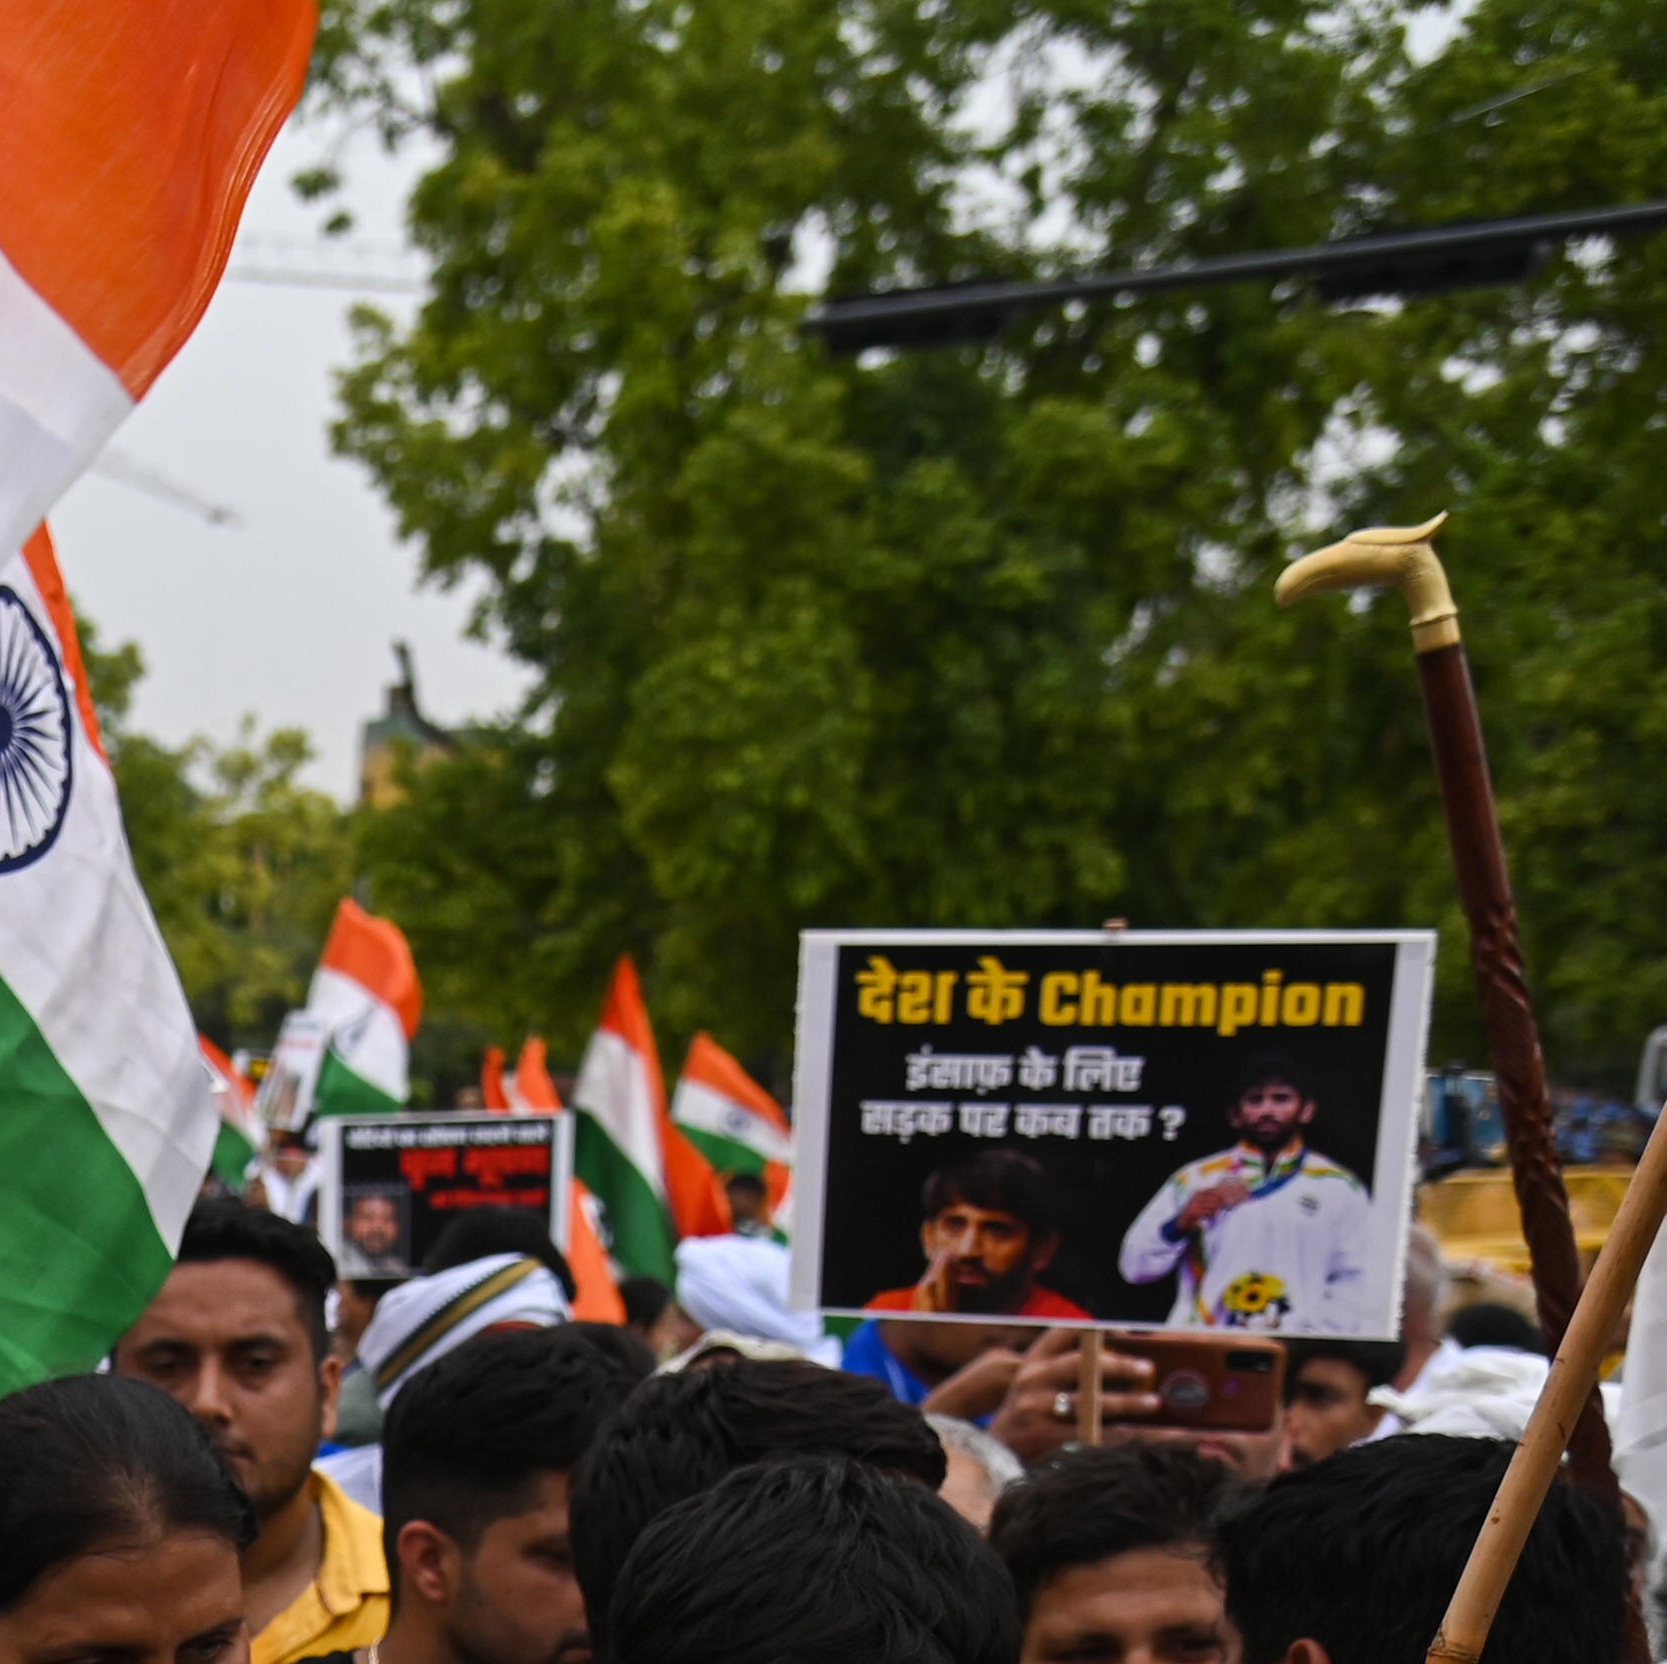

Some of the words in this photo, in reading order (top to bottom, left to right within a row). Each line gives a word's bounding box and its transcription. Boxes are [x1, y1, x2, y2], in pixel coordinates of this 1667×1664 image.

[855, 954, 959, 1025] देश
[966, 954, 1030, 1025] के
[1038, 968, 1365, 1037] Champion
[1018, 1044, 1058, 1091] के
[1062, 1045, 1146, 1092] लिए
[860, 1100, 955, 1145] सड़क
[957, 1103, 1011, 1138] पर
[1013, 1104, 1085, 1140] कब
[1086, 1105, 1155, 1141] तक
